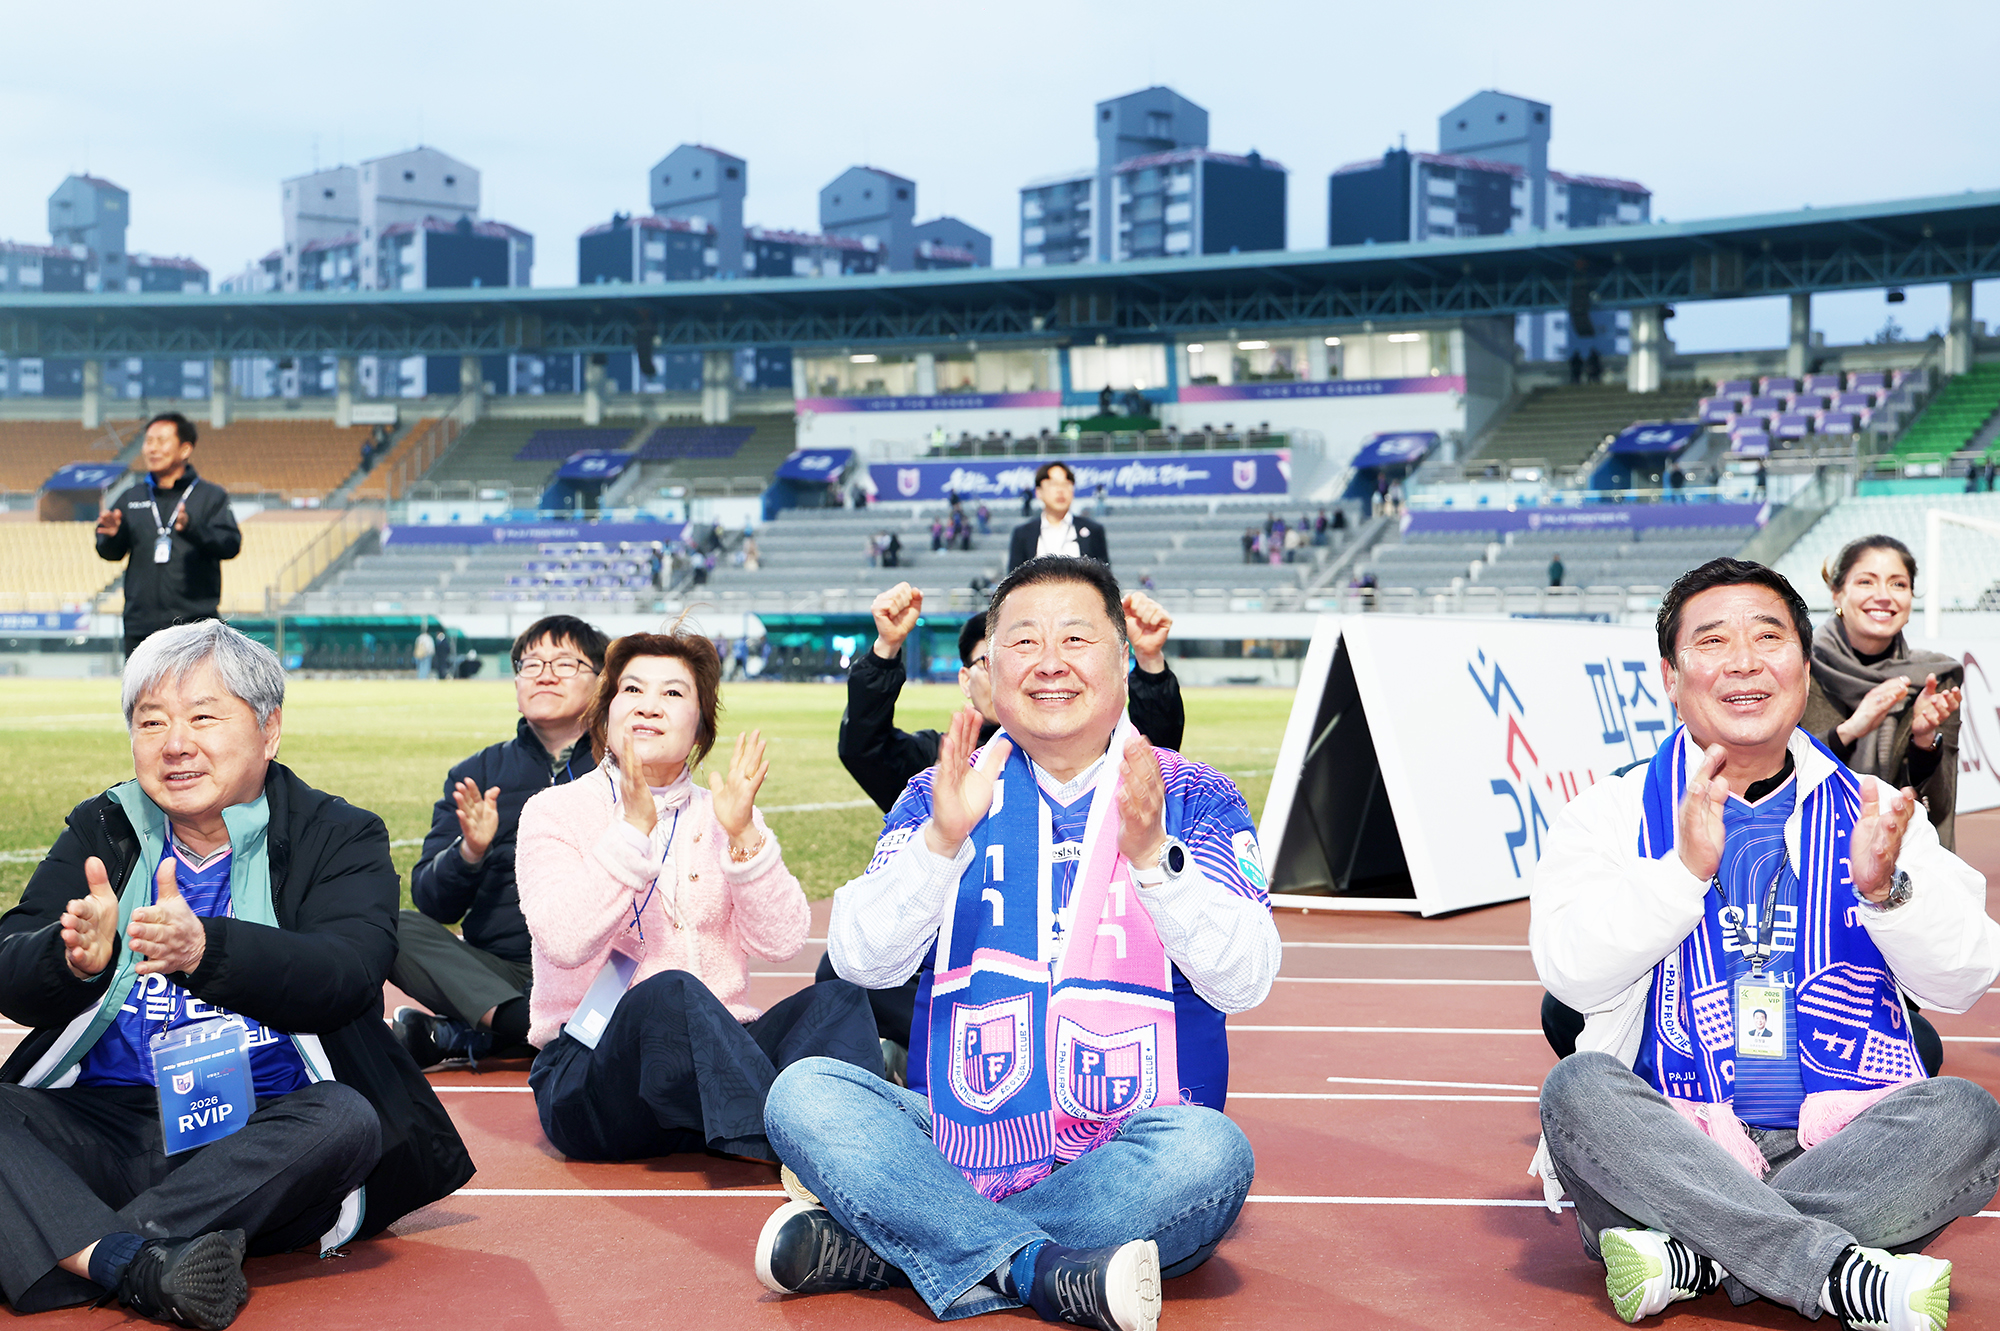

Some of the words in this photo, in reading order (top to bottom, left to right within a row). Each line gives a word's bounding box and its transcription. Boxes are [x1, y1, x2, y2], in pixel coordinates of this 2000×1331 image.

[1584, 657, 1677, 762] 파주
[1664, 969, 1676, 1002] PAJU
[987, 1054, 1006, 1082] F
[1080, 1050, 1100, 1074] P
[1668, 1071, 1697, 1082] PAJU
[190, 1096, 219, 1111] 2026
[1111, 1079, 1131, 1105] F
[178, 1103, 233, 1134] RVIP
